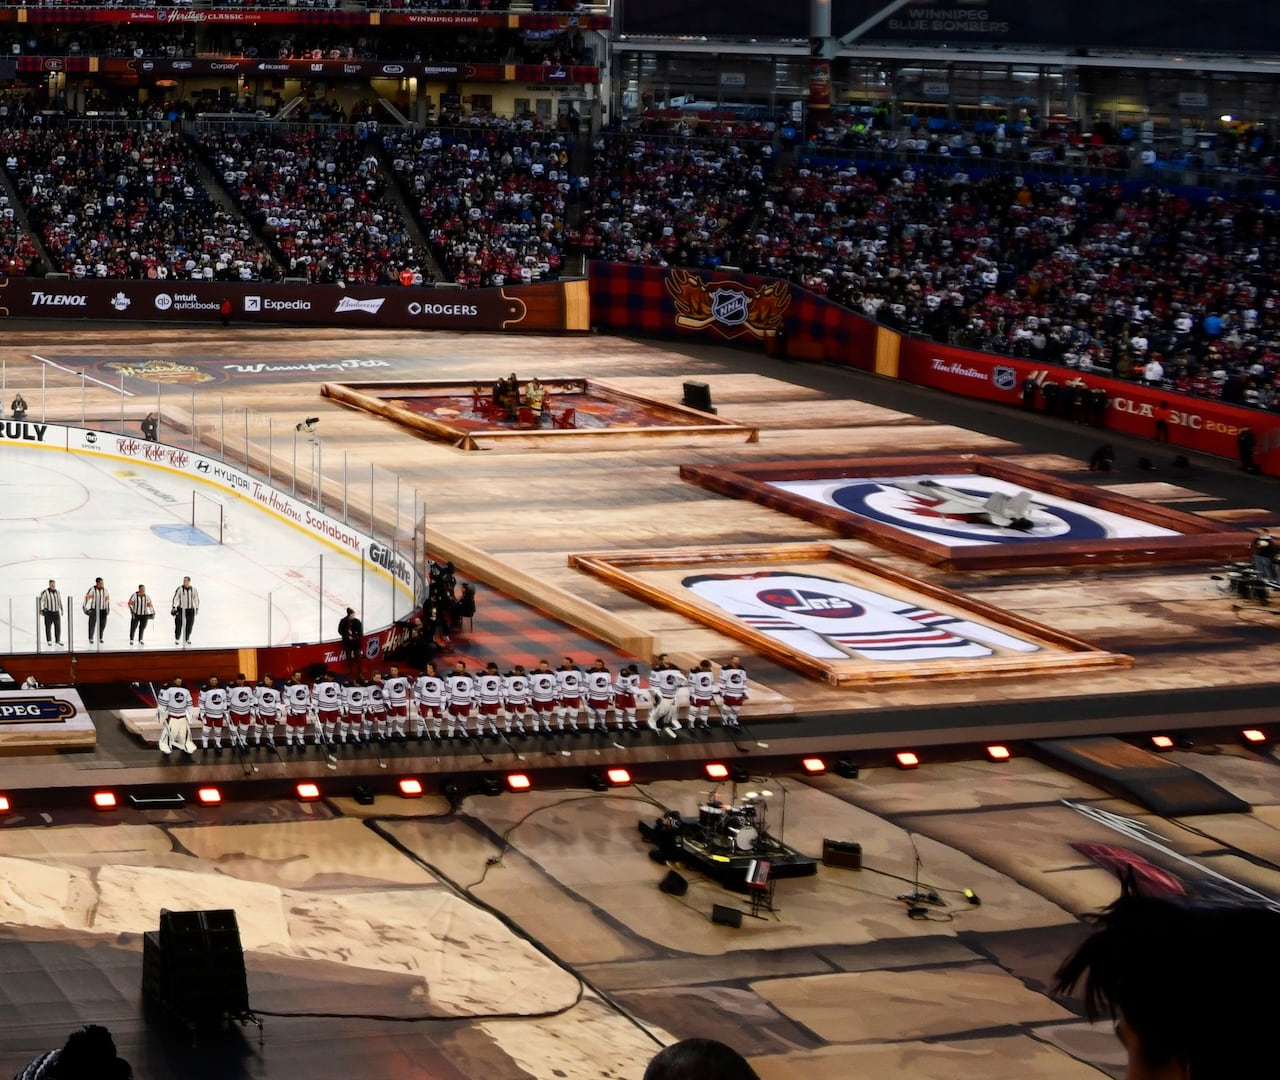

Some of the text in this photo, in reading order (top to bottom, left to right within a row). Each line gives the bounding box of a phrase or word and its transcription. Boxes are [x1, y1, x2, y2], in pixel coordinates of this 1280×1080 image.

[909, 9, 989, 21] WINNIPEG
[888, 19, 1009, 33] BLUE BOMBERS
[810, 37, 824, 57] 2
[31, 291, 88, 306] TYLENOL
[174, 293, 197, 302] intuit
[263, 298, 312, 311] Expedia
[174, 301, 221, 311] quickbooks
[424, 303, 478, 316] ROGERS
[720, 301, 742, 317] NHL
[931, 358, 989, 381] Tim Hortons
[81, 443, 101, 451] SPORTS
[119, 440, 141, 456] KitKat
[144, 445, 165, 461] KitKat
[168, 453, 189, 468] KitKat
[214, 466, 251, 491] HYUNDAI
[252, 481, 302, 522] Tim Hortons
[305, 510, 361, 552] Scotiabank
[369, 542, 412, 587] Gillette
[324, 650, 339, 664] Tim
